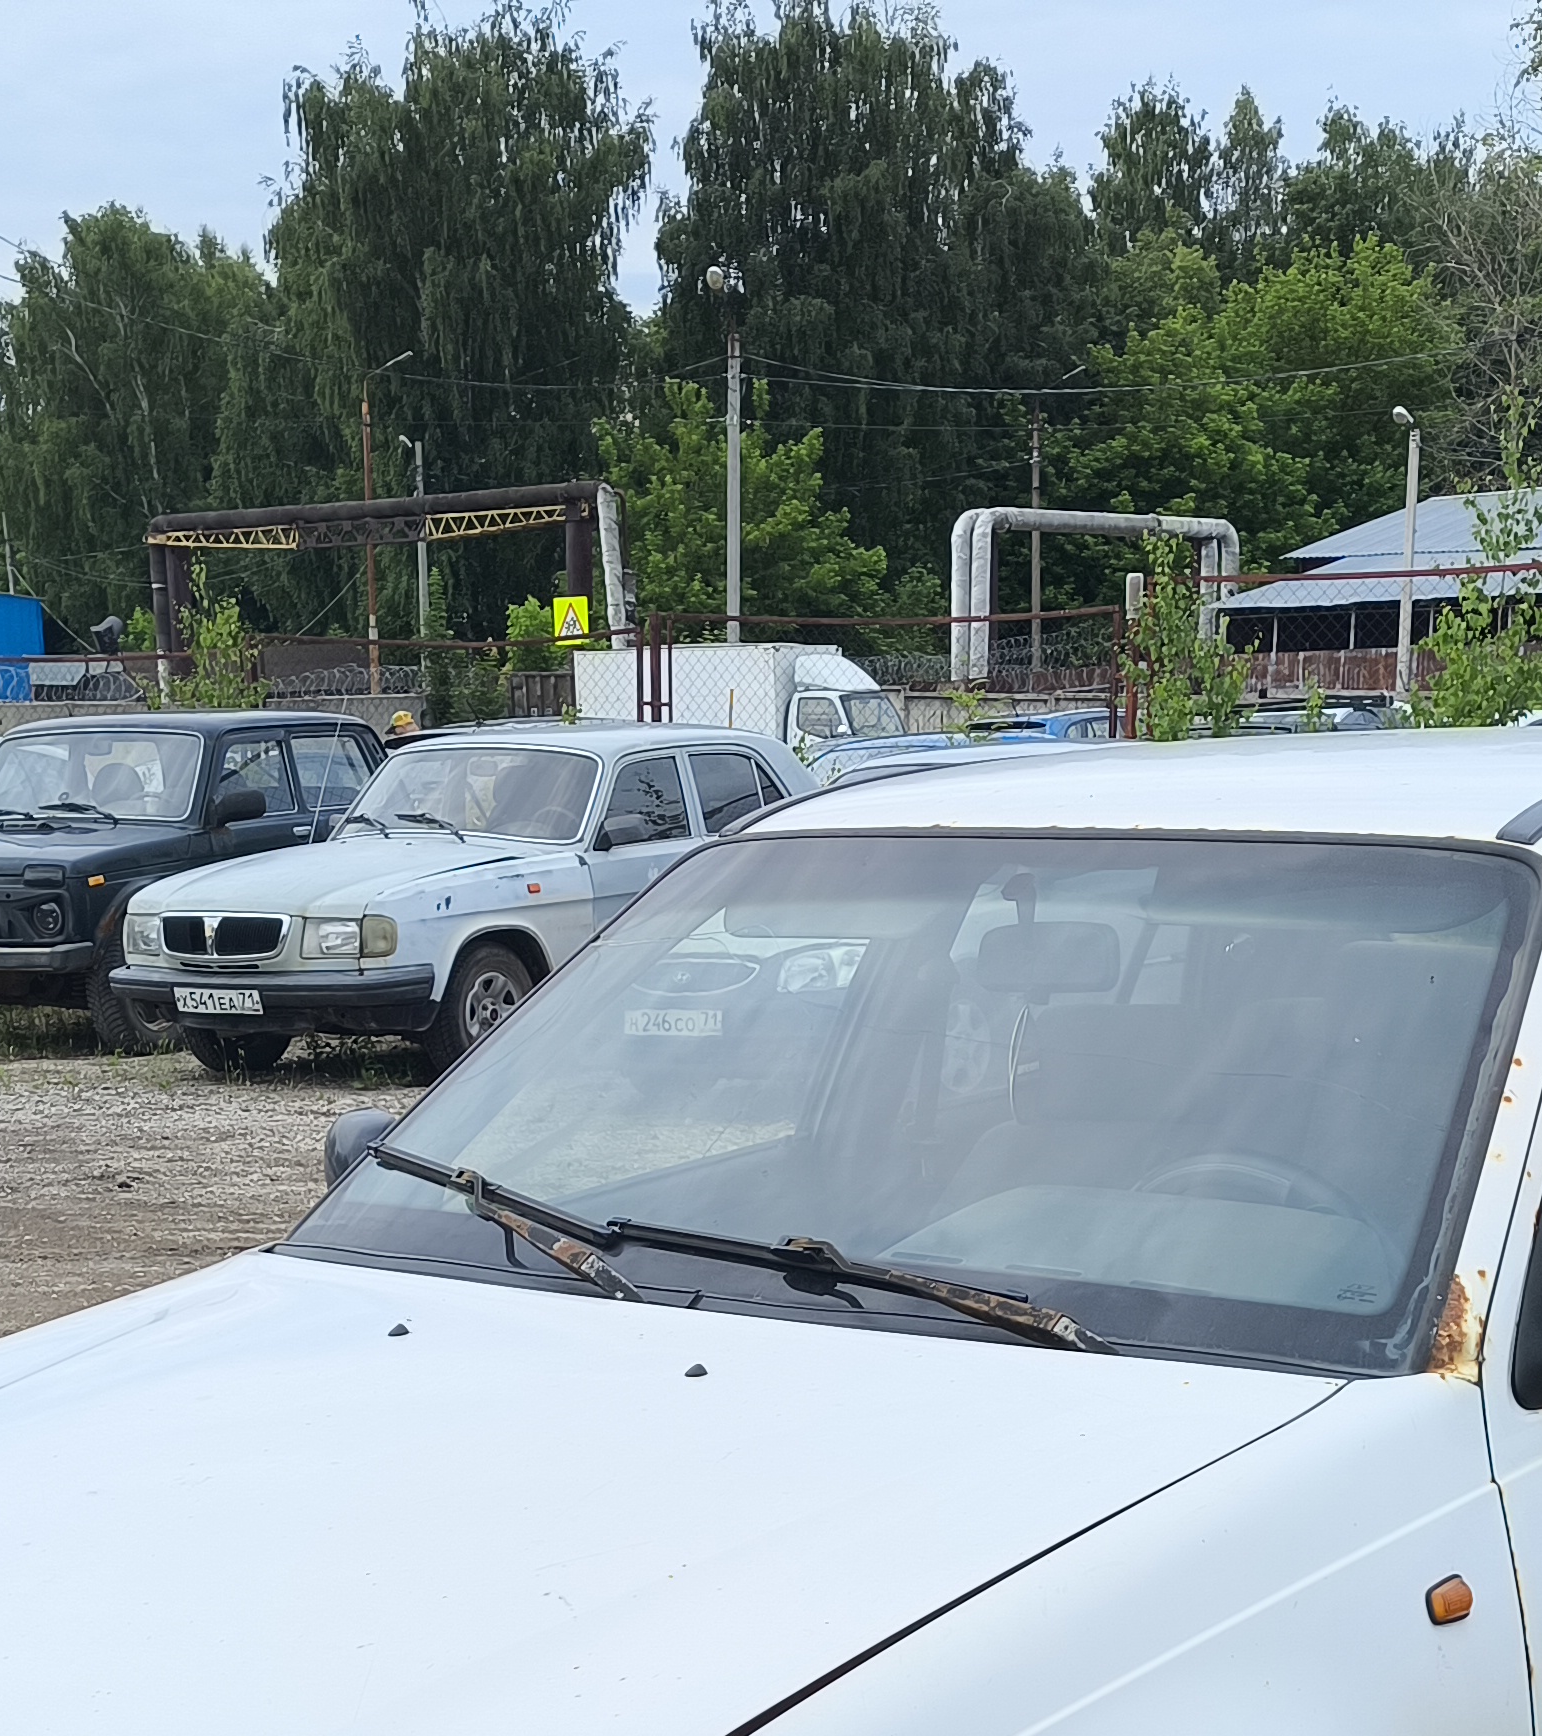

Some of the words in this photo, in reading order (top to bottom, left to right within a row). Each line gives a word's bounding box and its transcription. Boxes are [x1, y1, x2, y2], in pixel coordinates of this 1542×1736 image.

[180, 992, 238, 1011] Х541ЕА
[238, 992, 255, 1009] 71
[629, 1011, 695, 1032] Н246СО
[700, 1011, 718, 1027] 71
